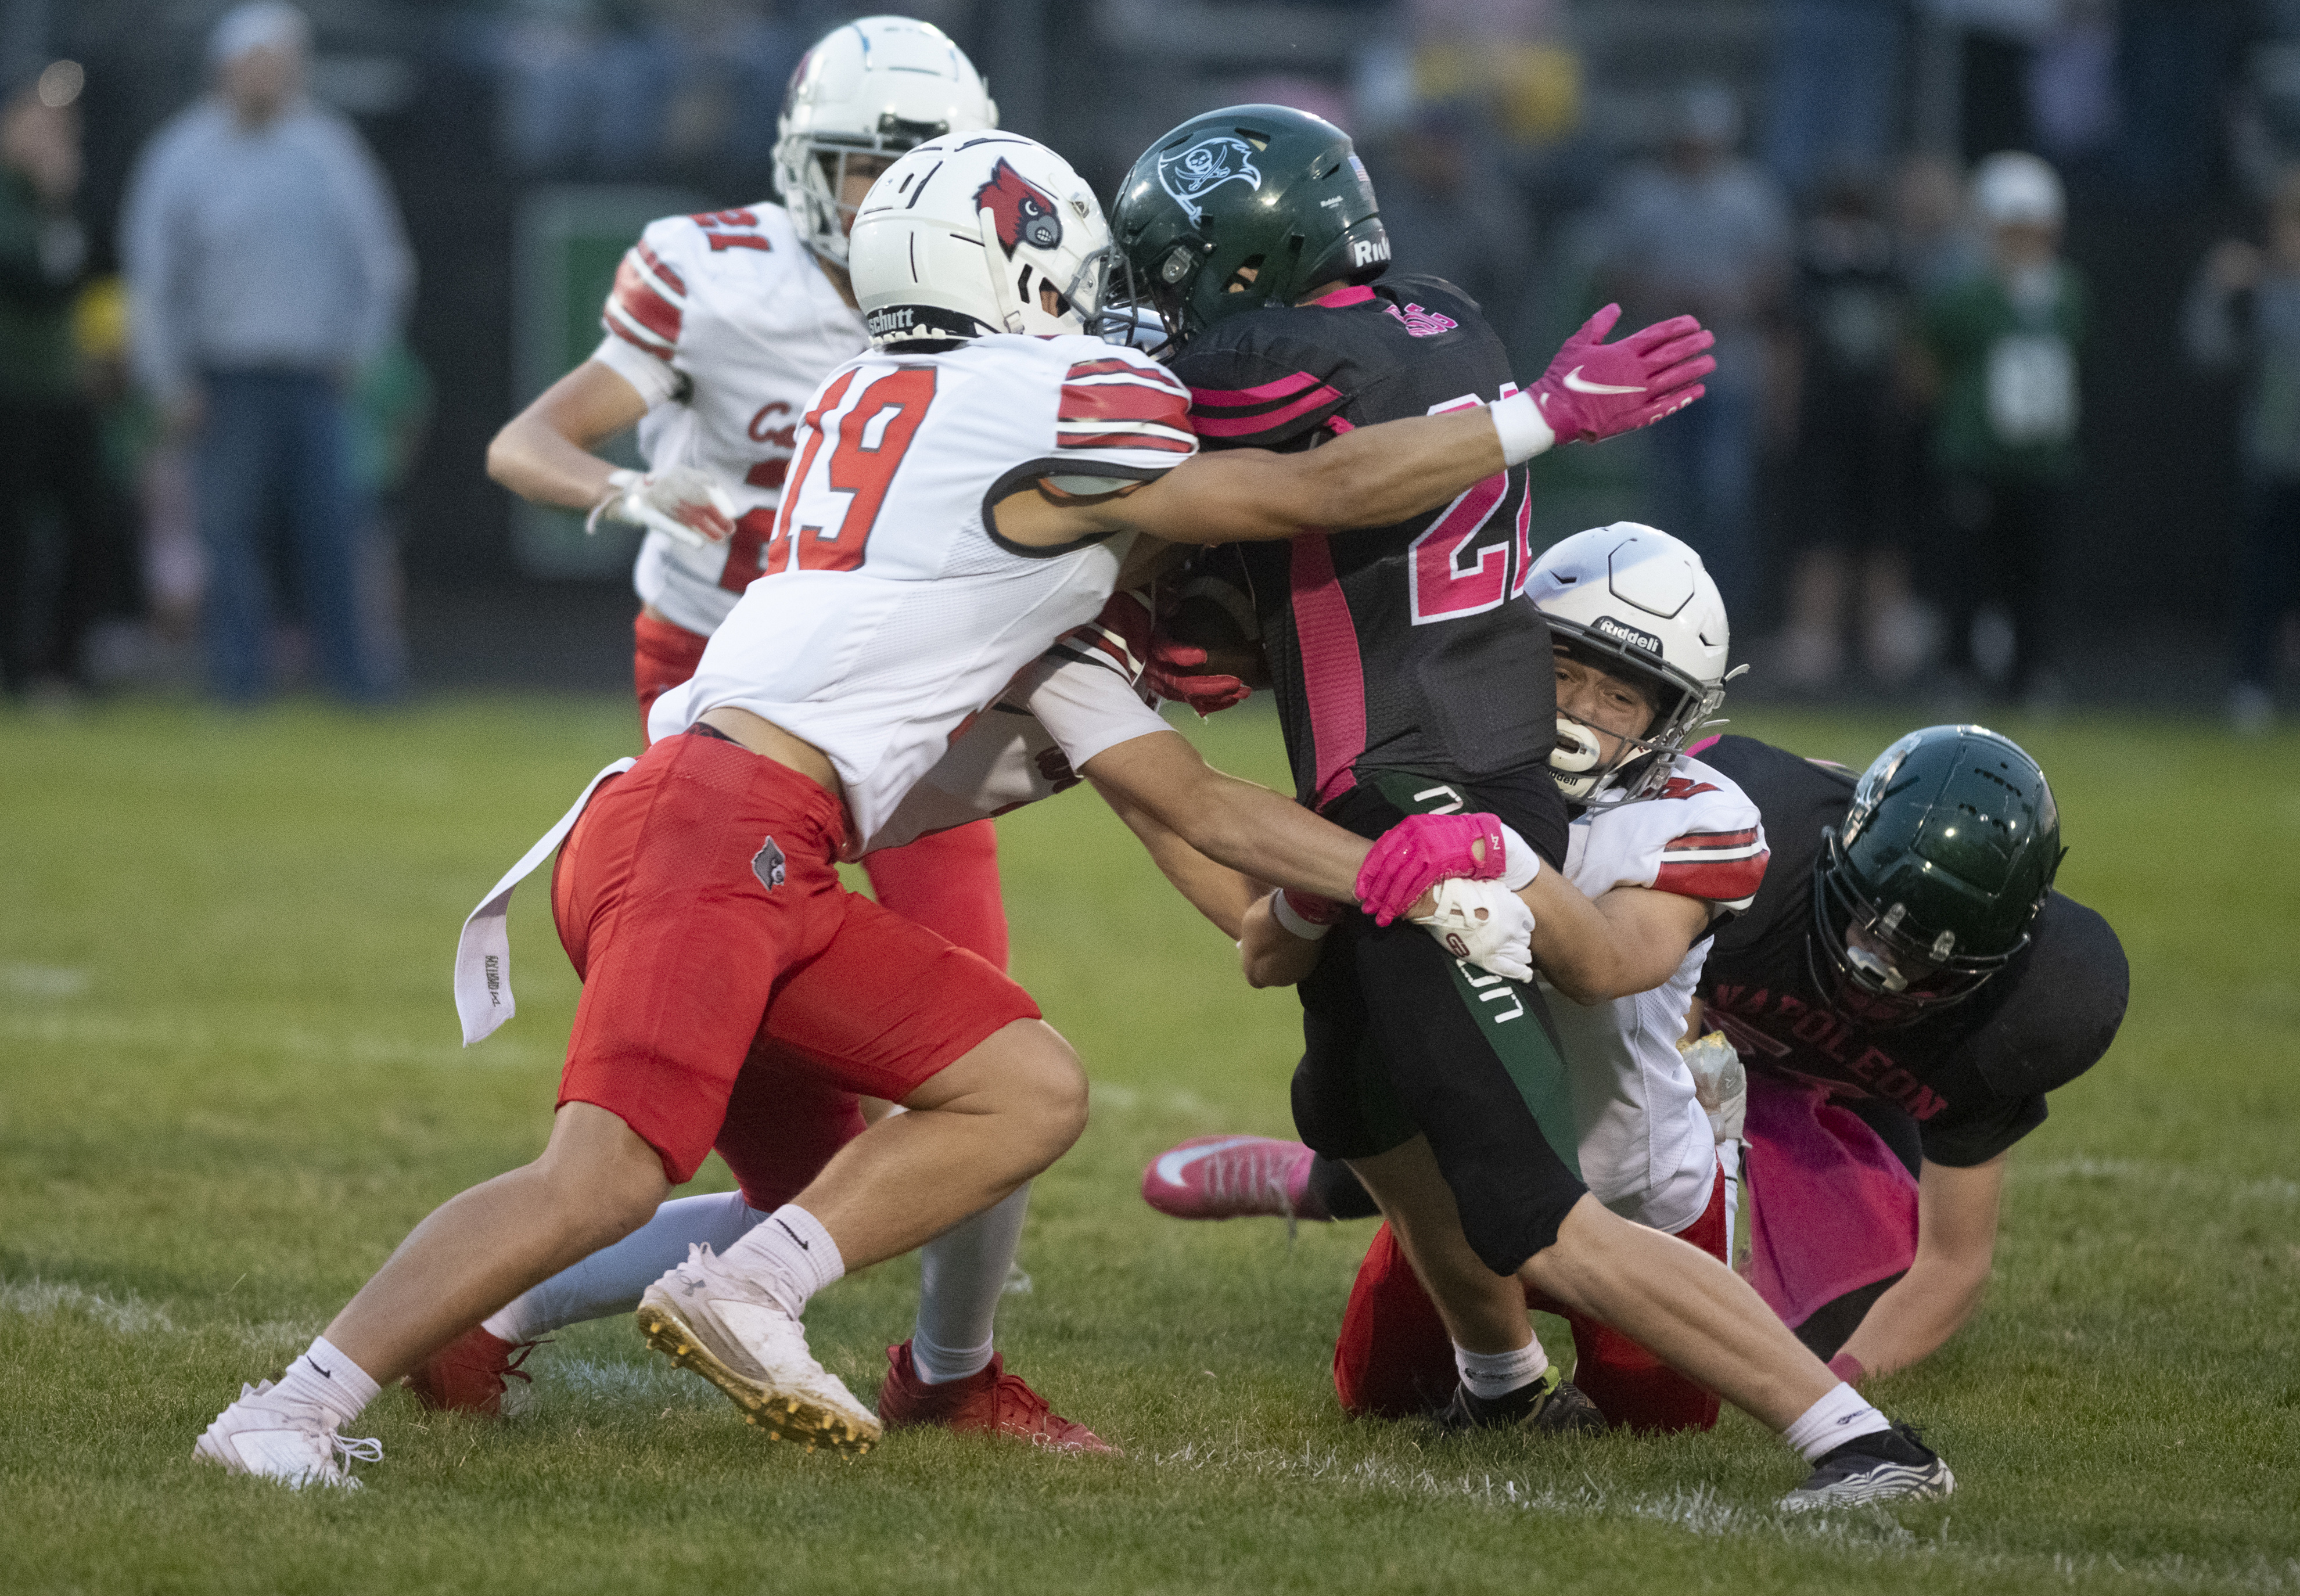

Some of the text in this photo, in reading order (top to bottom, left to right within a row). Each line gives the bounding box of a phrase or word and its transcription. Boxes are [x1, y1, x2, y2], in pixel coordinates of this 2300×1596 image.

[868, 308, 914, 336] schutt
[761, 366, 937, 578] 19
[1600, 620, 1660, 652] Riddell
[1715, 983, 1949, 1121] NAPOLEON
